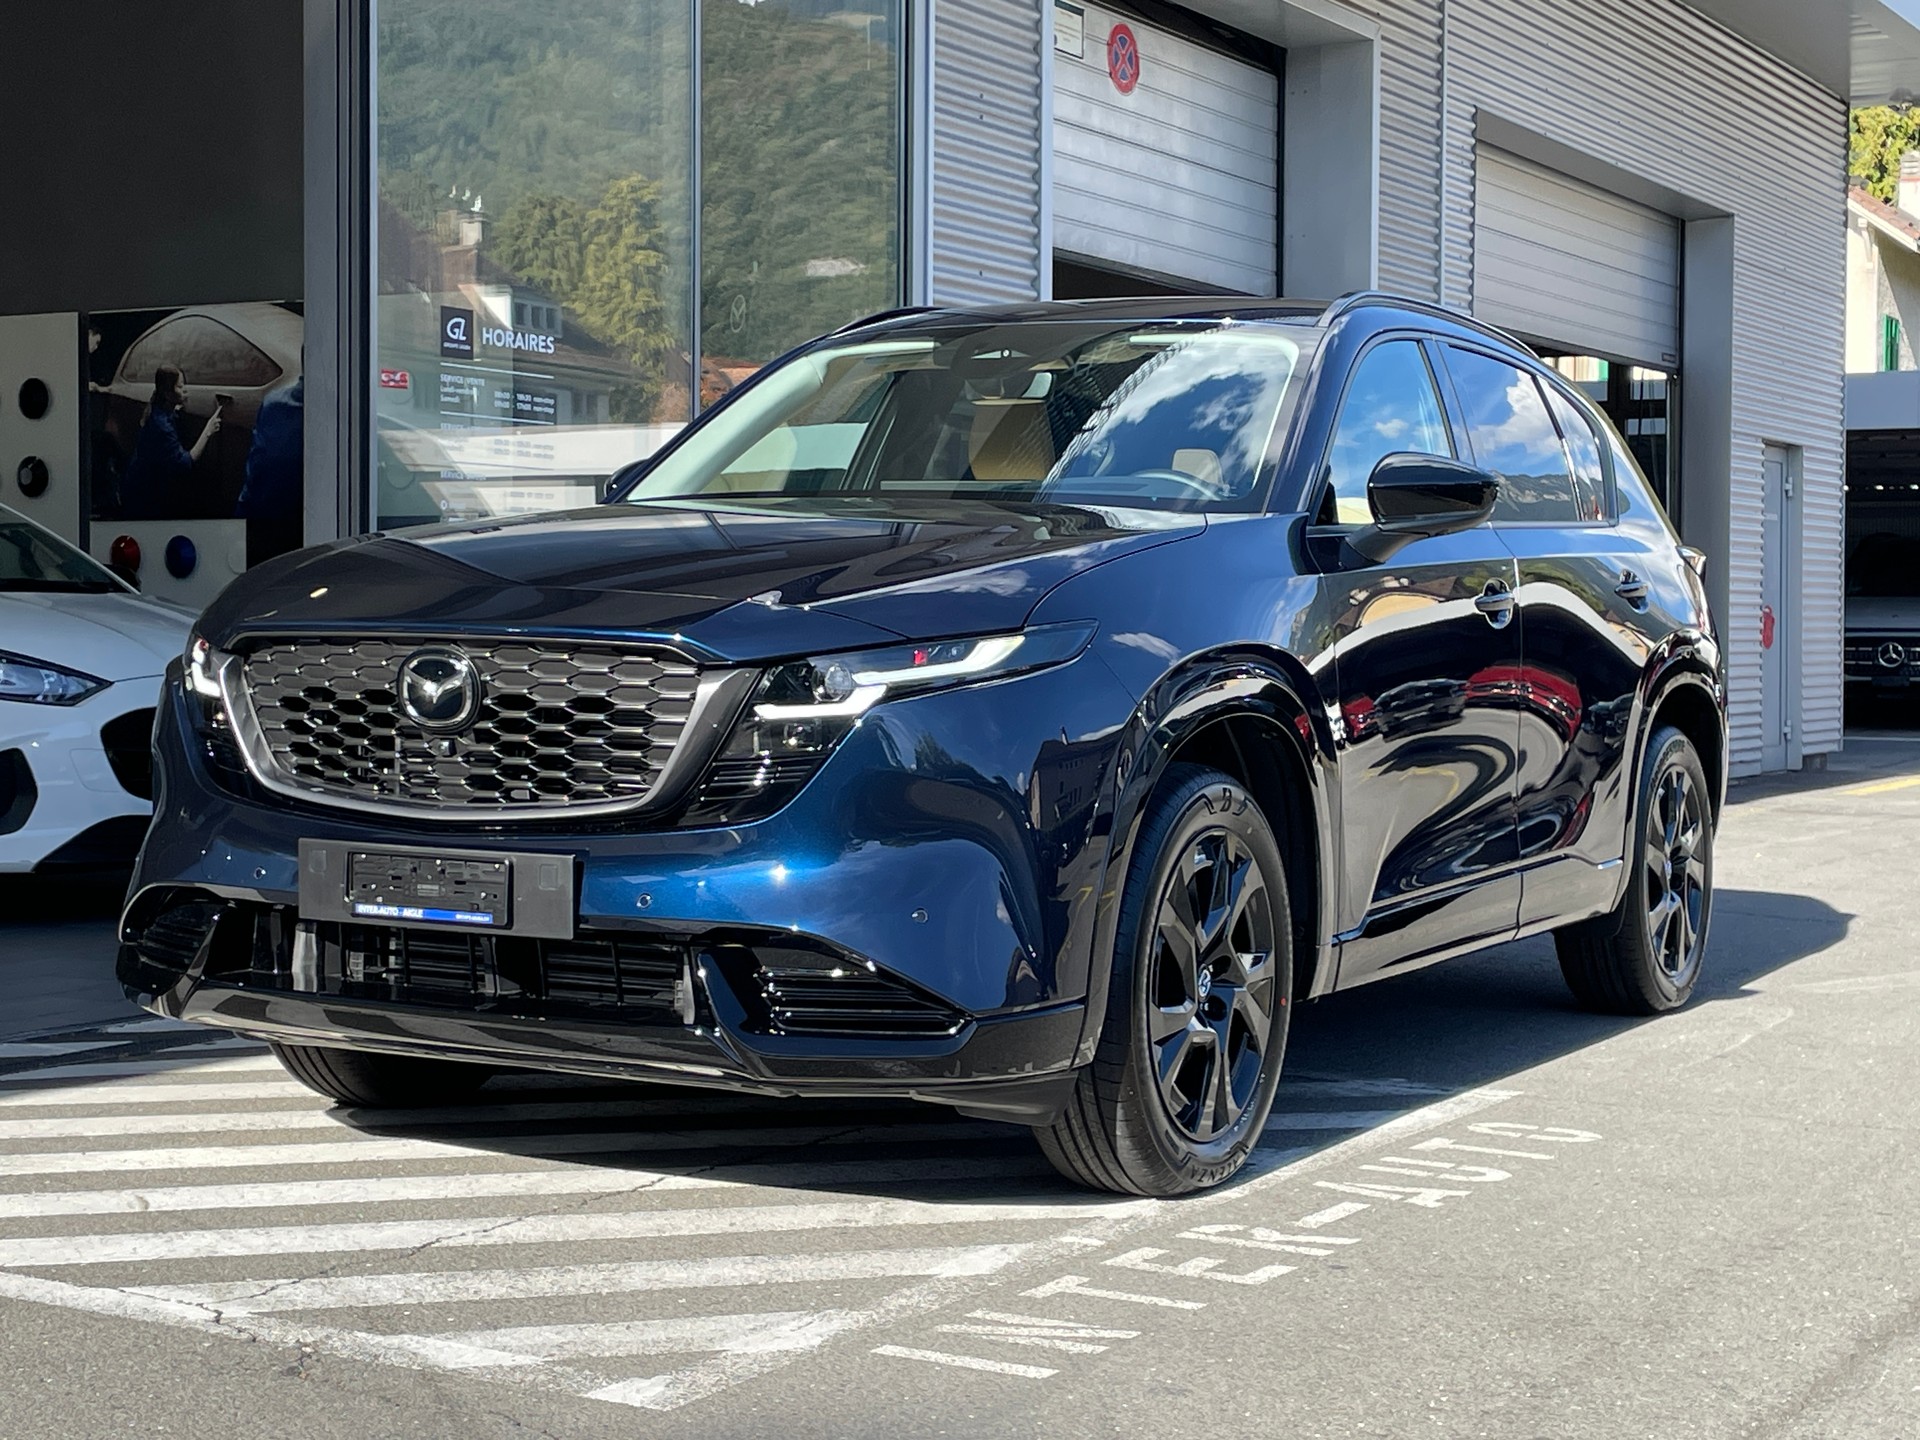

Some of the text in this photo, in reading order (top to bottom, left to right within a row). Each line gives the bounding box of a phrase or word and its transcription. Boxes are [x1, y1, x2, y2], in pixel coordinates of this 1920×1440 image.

[482, 327, 555, 354] HORAIRES
[440, 373, 464, 385] SERVICE
[403, 907, 424, 919] AIGLE
[869, 1121, 1603, 1379] INTER-AUTO
